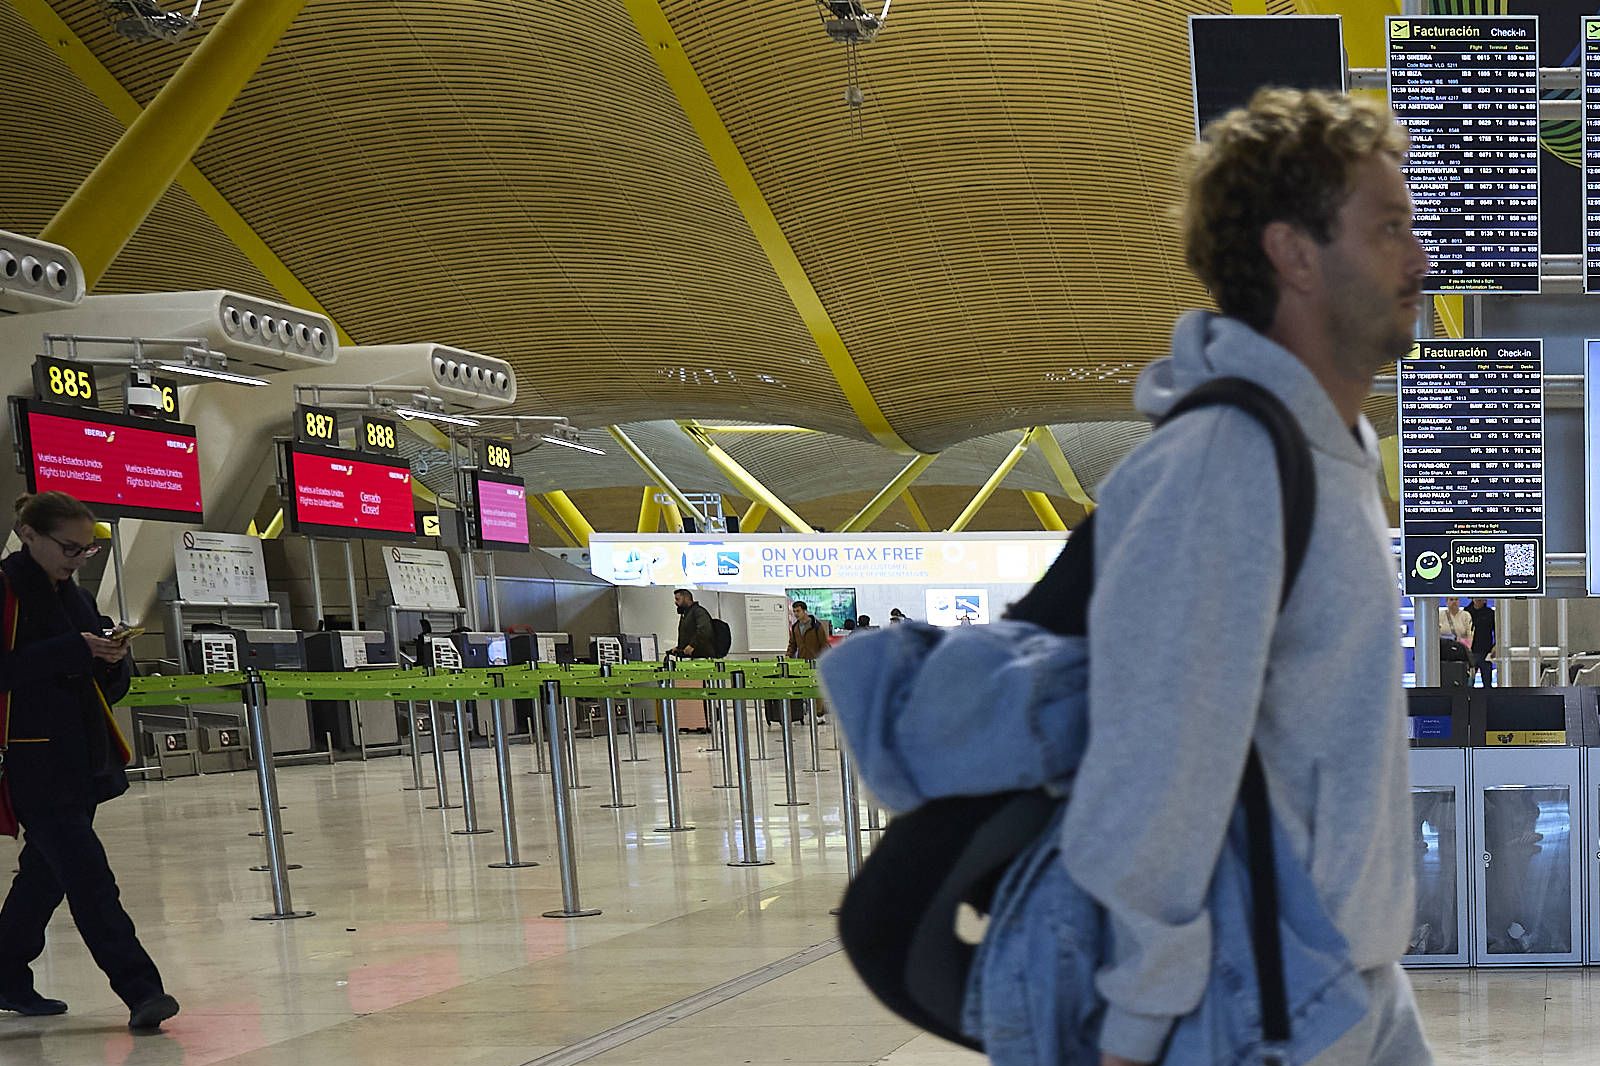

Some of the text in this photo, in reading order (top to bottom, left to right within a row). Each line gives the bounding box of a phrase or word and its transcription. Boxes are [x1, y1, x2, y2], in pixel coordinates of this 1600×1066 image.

[1414, 26, 1479, 36] Facturación
[1491, 28, 1526, 36] Check-in
[1424, 348, 1487, 357] Facturación
[1498, 349, 1531, 357] Check-in
[49, 366, 91, 398] 885
[306, 413, 333, 439] 887
[84, 428, 107, 438] IBERIA
[367, 423, 394, 448] 888
[166, 440, 186, 449] IBERIA
[38, 453, 57, 462] Vuelos
[62, 456, 83, 467] Estados
[84, 459, 102, 469] Unidos
[488, 445, 510, 468] 889
[40, 467, 58, 478] Flights
[66, 470, 84, 480] United
[85, 471, 102, 482] States
[360, 492, 381, 504] Cerrado
[362, 504, 379, 515] Closed
[762, 548, 924, 561] ON YOUR TAX FREE
[1456, 546, 1495, 554] ¿Necesitas
[1456, 555, 1482, 564] ayuda?
[763, 564, 831, 577] REFUND
